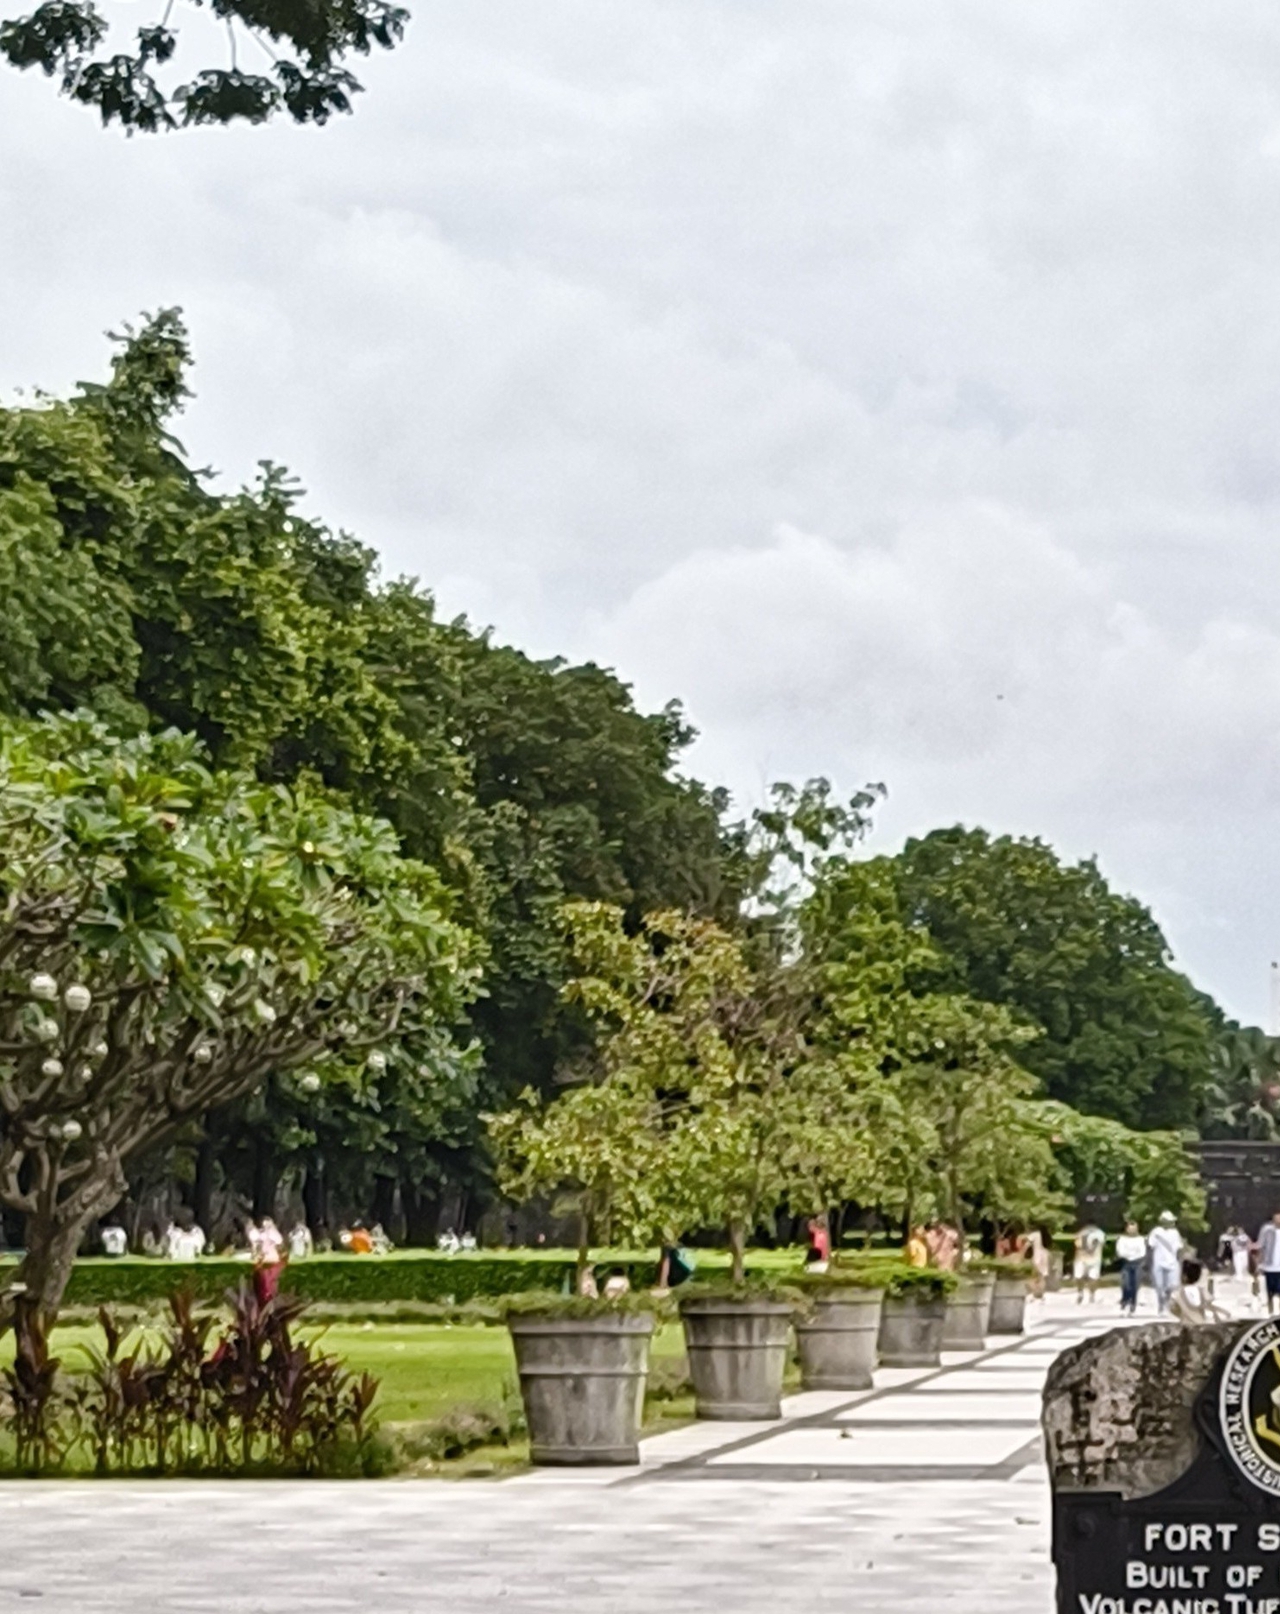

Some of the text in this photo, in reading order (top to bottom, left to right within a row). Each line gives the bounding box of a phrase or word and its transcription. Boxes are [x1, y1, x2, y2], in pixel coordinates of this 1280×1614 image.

[1144, 1522, 1239, 1552] FORT
[1126, 1560, 1210, 1589] BUILT
[1225, 1560, 1263, 1589] OF
